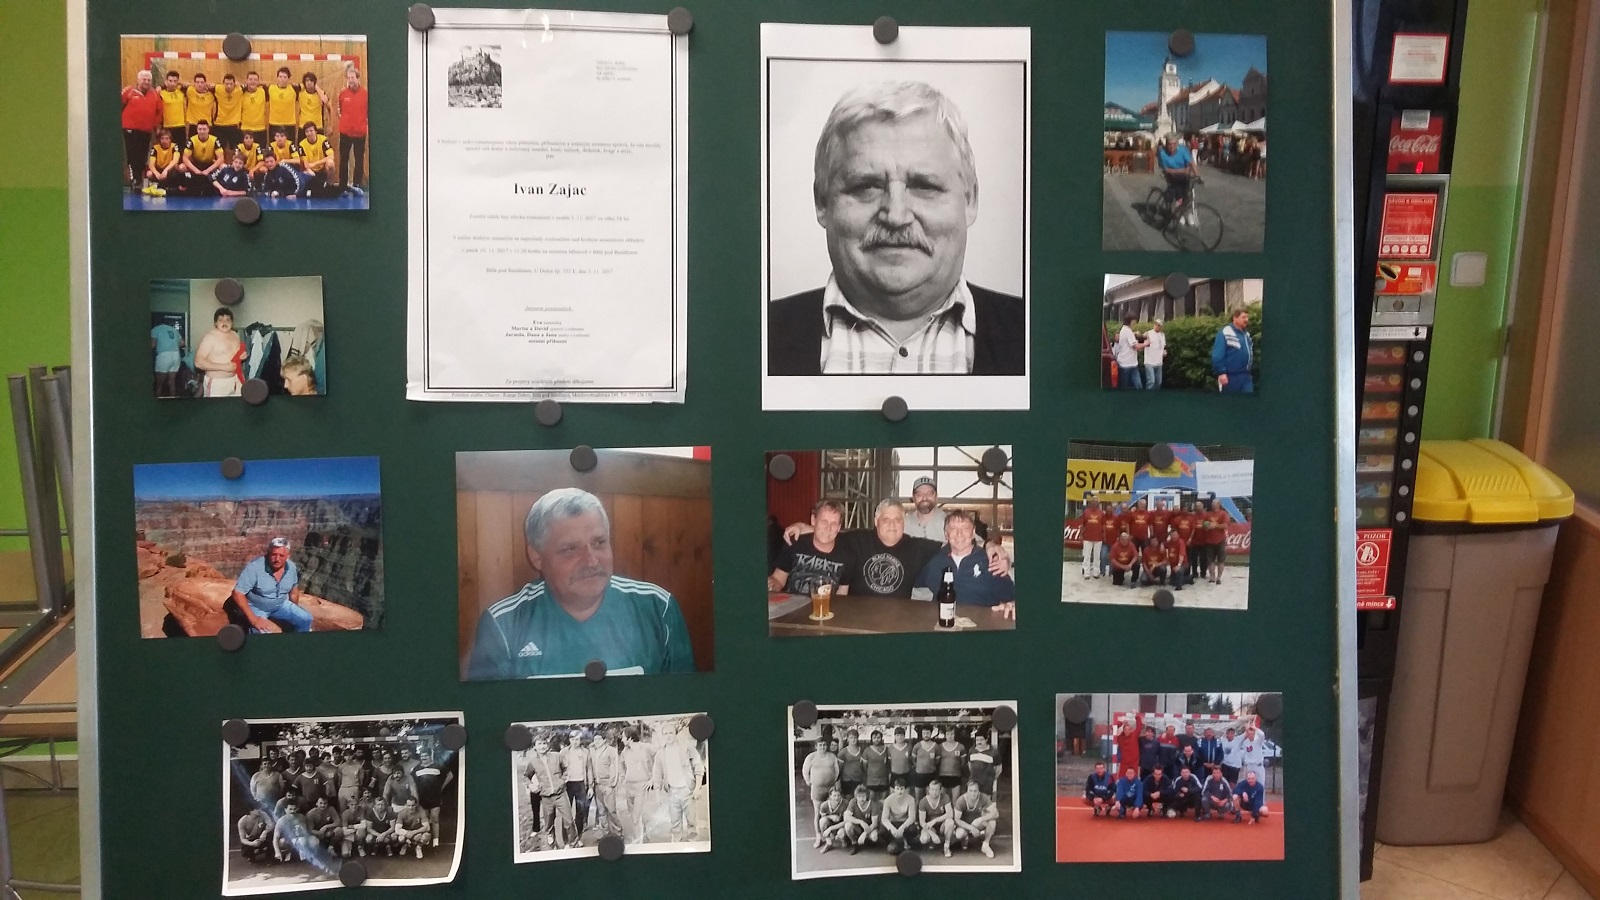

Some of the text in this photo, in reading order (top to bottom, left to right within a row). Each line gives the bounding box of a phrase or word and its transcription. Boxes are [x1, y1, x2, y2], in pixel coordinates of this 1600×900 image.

[1389, 134, 1441, 155] Coca-Cola
[513, 182, 588, 199] Ivan Zajac
[1365, 599, 1385, 608] mince
